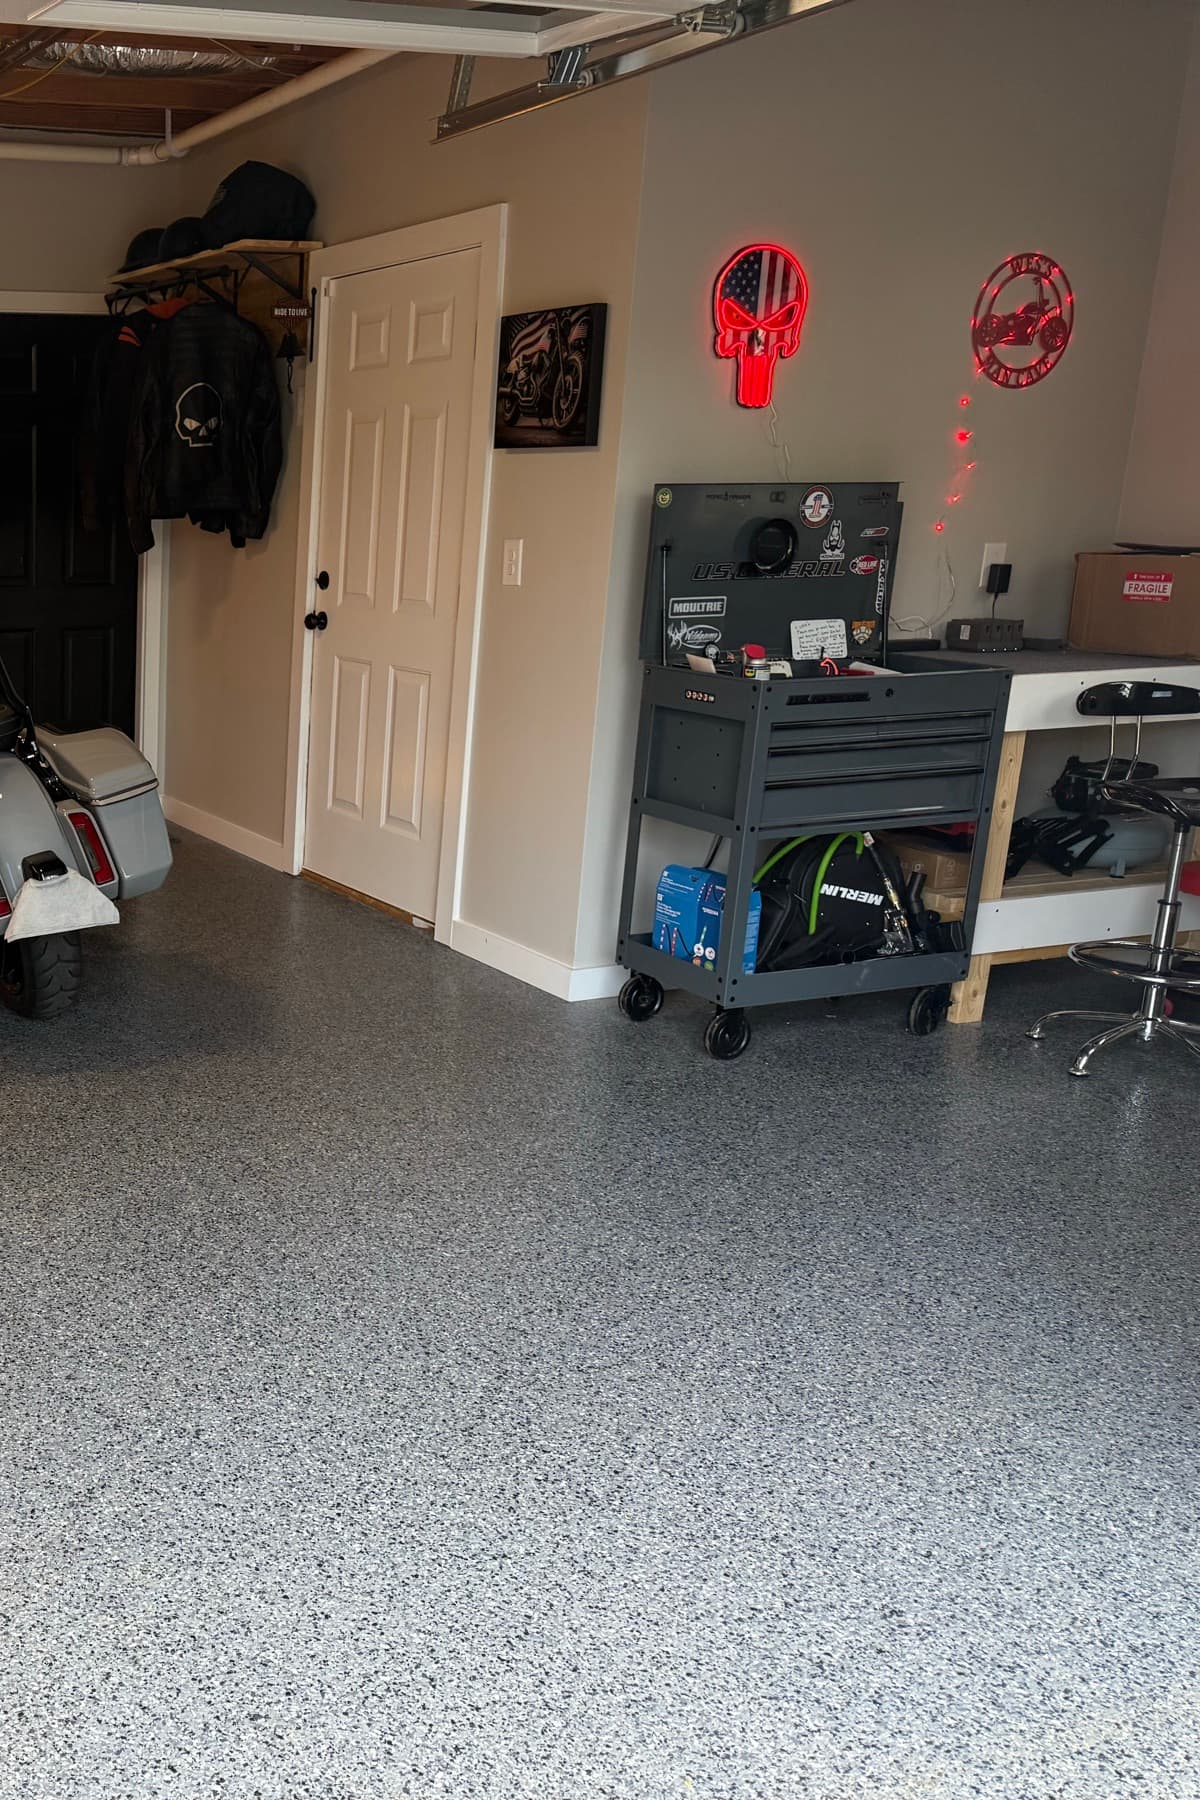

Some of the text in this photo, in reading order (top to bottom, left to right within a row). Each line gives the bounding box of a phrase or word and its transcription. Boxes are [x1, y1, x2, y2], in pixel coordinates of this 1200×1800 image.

[288, 308, 296, 317] TO
[1128, 583, 1169, 594] FRAGILE
[673, 601, 724, 613] MOULTRIE
[820, 883, 884, 906] MERLIN
